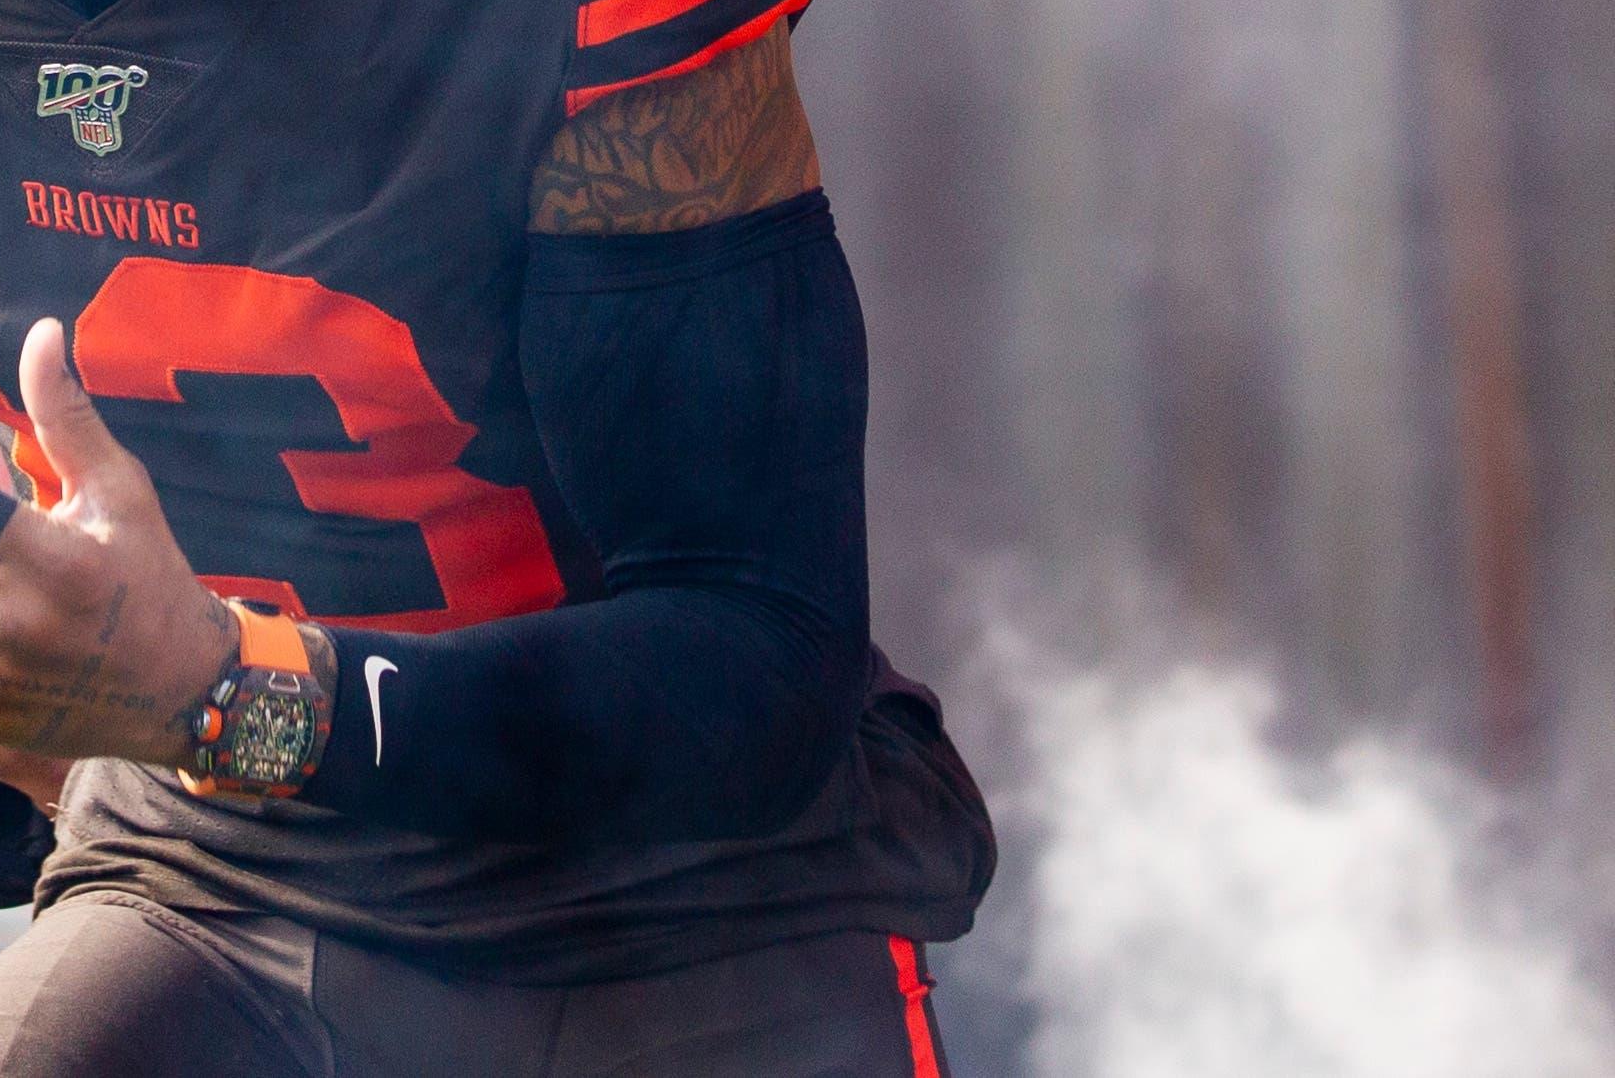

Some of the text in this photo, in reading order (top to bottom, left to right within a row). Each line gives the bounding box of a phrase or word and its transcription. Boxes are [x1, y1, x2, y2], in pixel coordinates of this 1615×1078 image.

[41, 68, 128, 112] 100
[80, 122, 113, 143] NFL
[21, 180, 200, 250] BROWNS
